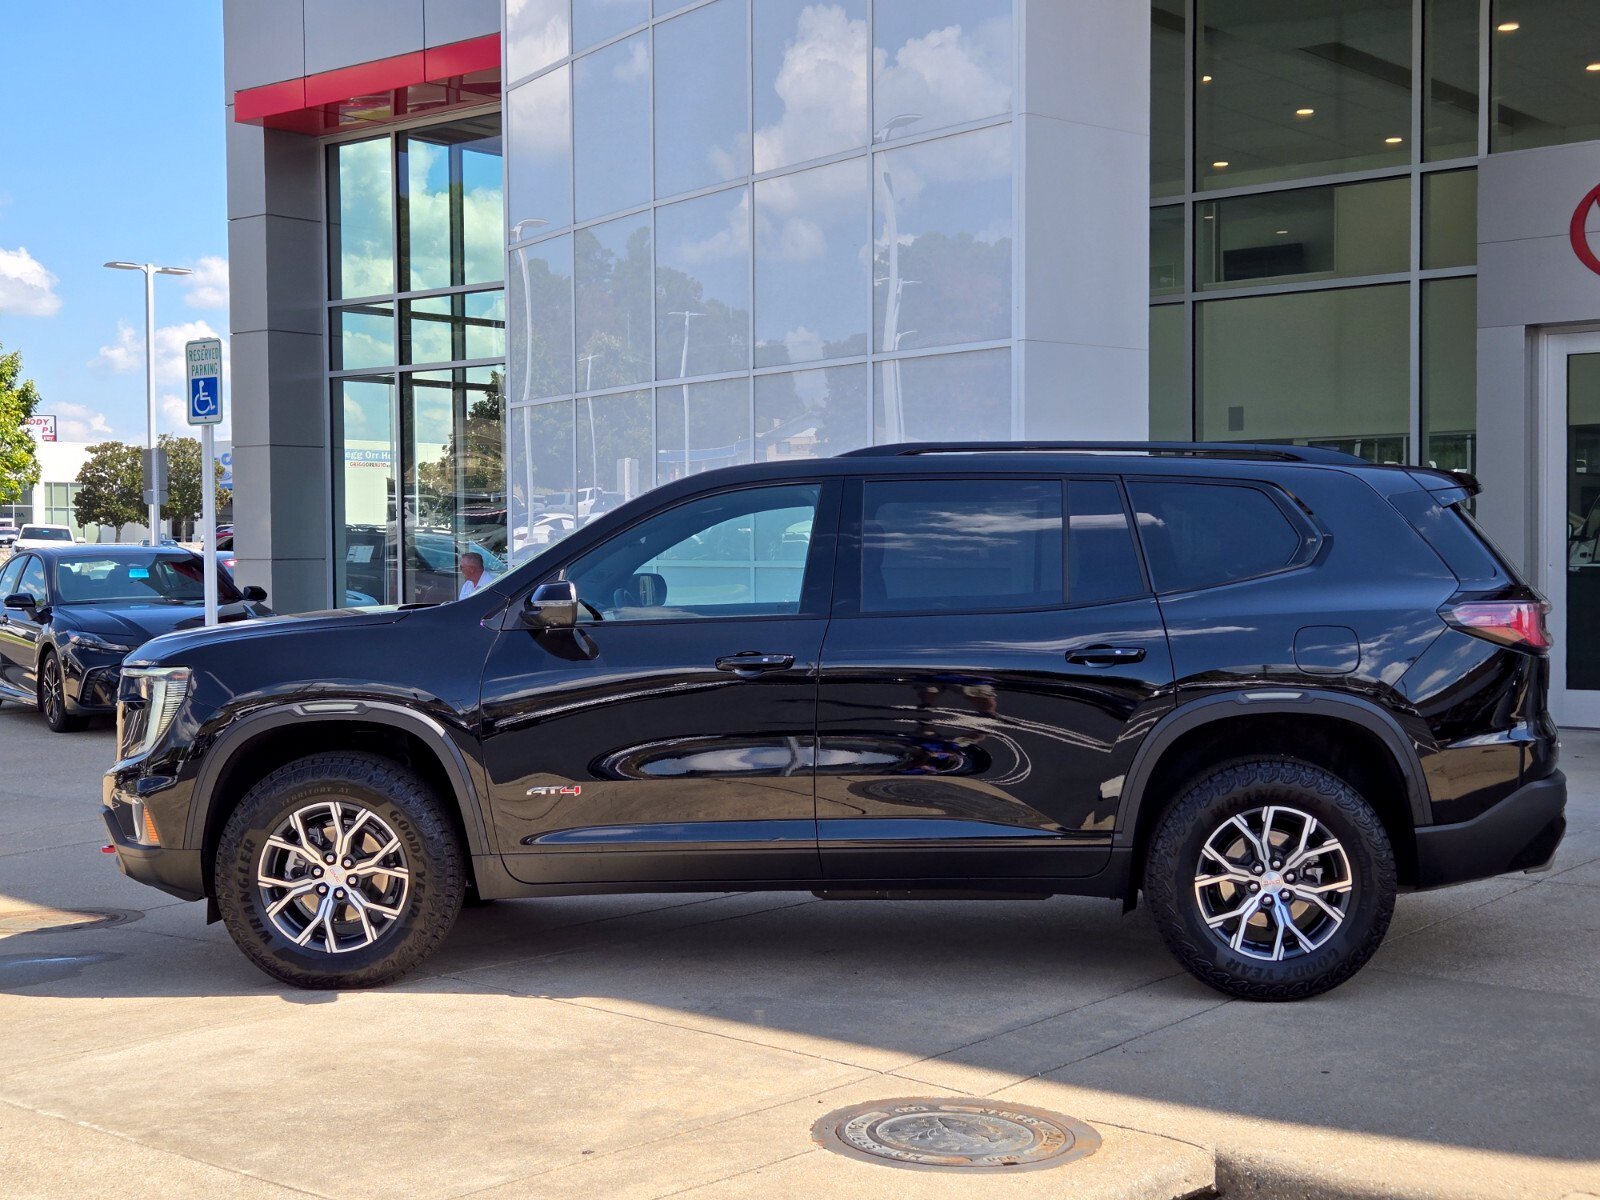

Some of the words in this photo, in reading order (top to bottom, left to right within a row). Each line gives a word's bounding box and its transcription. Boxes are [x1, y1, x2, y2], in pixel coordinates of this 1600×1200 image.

[189, 347, 219, 361] RESERVED
[191, 362, 218, 376] PARKING
[345, 451, 363, 460] egg
[365, 451, 379, 459] Orr
[526, 786, 581, 796] AT4
[390, 810, 426, 918] GOODYEAR
[237, 838, 274, 945] WRANGLER
